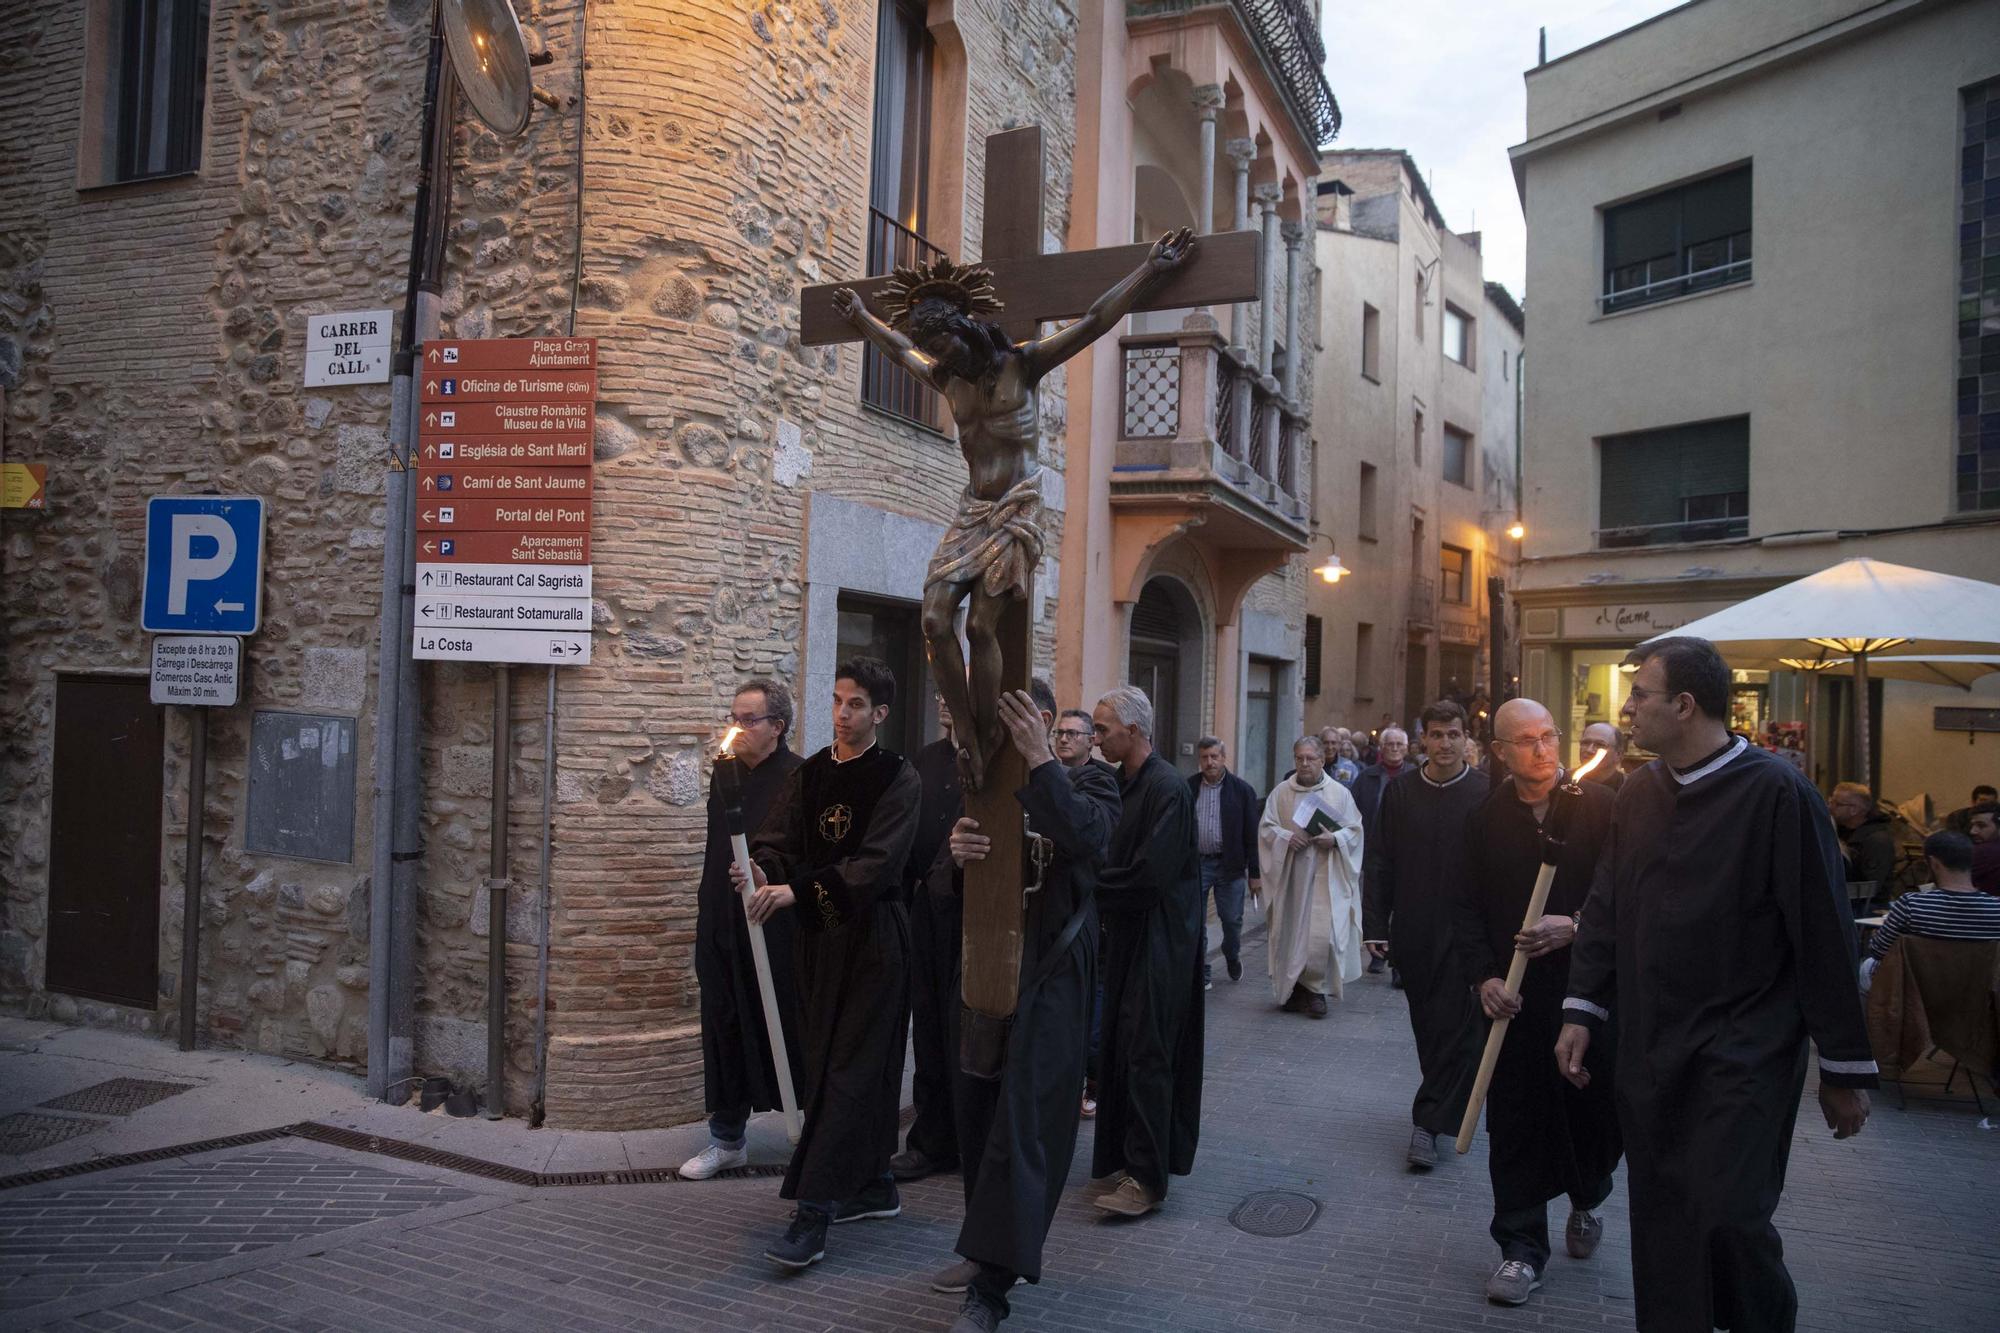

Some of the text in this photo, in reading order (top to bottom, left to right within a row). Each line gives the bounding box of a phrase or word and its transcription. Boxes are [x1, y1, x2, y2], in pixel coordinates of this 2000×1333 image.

[321, 321, 378, 338] CARRER
[334, 342, 361, 356] DEL
[533, 340, 590, 354] Plaça Gran
[328, 360, 365, 375] CALL
[529, 354, 590, 367] Ajuntament
[461, 380, 590, 393] Oficina de Turisme (50m)
[495, 405, 587, 417] Claustre Romànic
[504, 418, 586, 429] Museu de la Vila
[459, 443, 587, 460] Església de Sant Martí
[463, 475, 586, 489] Camí de Sant Jaume
[496, 508, 585, 522] Portal del Pont
[441, 542, 451, 554] P
[520, 535, 583, 548] Aparcament
[511, 548, 583, 560] Sant Sebastià
[166, 513, 238, 616] P
[454, 573, 583, 591] Restaurant Cal Sagristà
[454, 606, 583, 620] Restaurant Sotamuralla
[157, 643, 186, 656] Excepte
[187, 644, 197, 655] de
[198, 645, 204, 655] 8
[217, 645, 227, 656] 20
[228, 645, 234, 656] h
[420, 637, 473, 651] La Costa
[156, 657, 233, 672] Càrrega i Descàrrega
[193, 672, 212, 684] Casc
[213, 673, 233, 684] Antic
[167, 685, 219, 697] Màxim 30 min.
